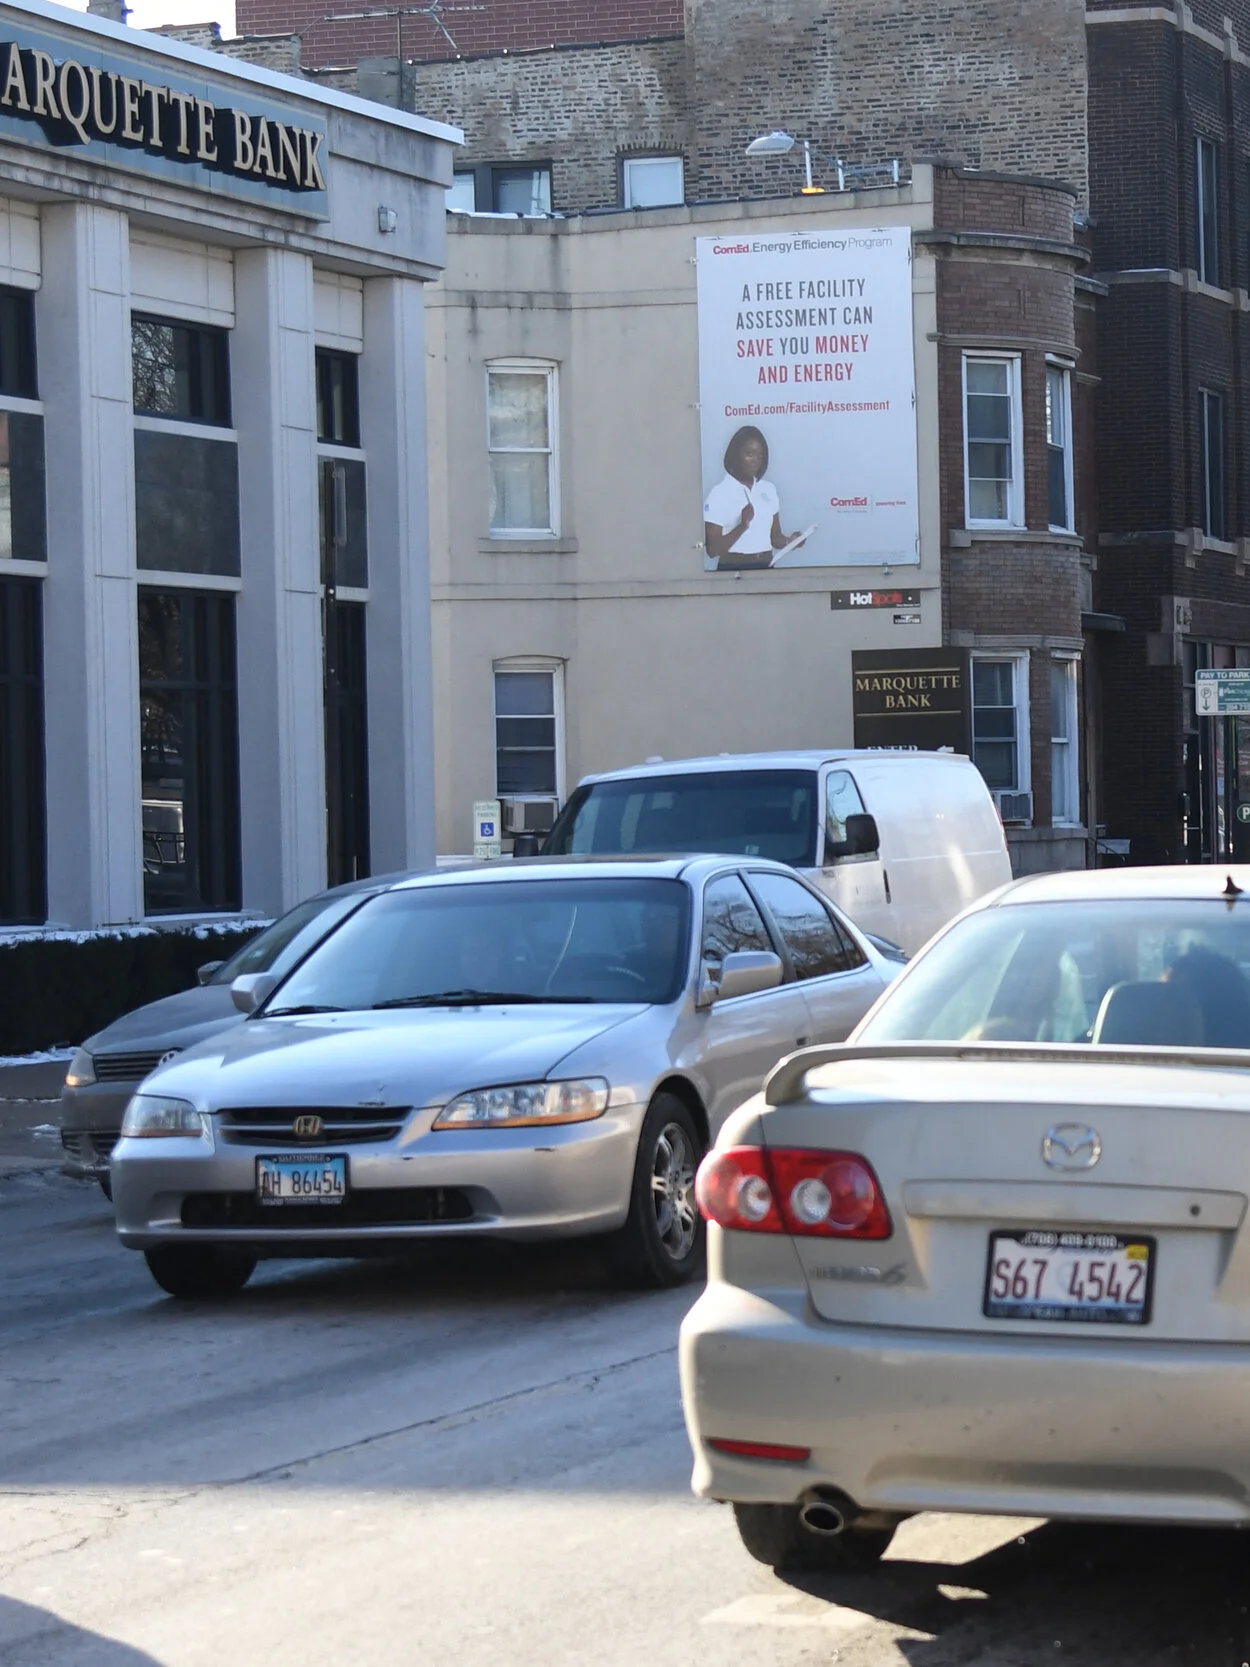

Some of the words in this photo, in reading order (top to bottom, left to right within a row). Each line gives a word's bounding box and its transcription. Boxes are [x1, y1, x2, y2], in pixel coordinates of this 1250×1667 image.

[233, 108, 328, 191] BANK
[713, 243, 750, 255] ComEd
[752, 241, 792, 254] Energy
[793, 238, 847, 252] Efficiency
[849, 237, 892, 250] Program
[742, 284, 751, 302] A
[756, 281, 793, 301] FREE
[799, 278, 866, 299] FACILITY
[736, 307, 837, 330] ASSESSMENT
[843, 305, 873, 325] CAN
[737, 338, 774, 358] SAVE
[779, 336, 809, 356] YOU
[815, 334, 869, 354] MONEY
[758, 365, 788, 385] AND
[794, 362, 853, 383] ENERGY
[724, 400, 890, 417] ComEd.com/FacilityAssessment
[830, 496, 868, 507] ComEd
[855, 675, 961, 693] MARQUETTE
[1200, 671, 1216, 679] PAY
[1217, 671, 1227, 679] TO
[1229, 671, 1250, 679] PARK
[886, 694, 932, 709] BANK
[292, 1169, 342, 1194] 86454
[992, 1258, 1049, 1299] S67
[1068, 1260, 1146, 1304] 4542
